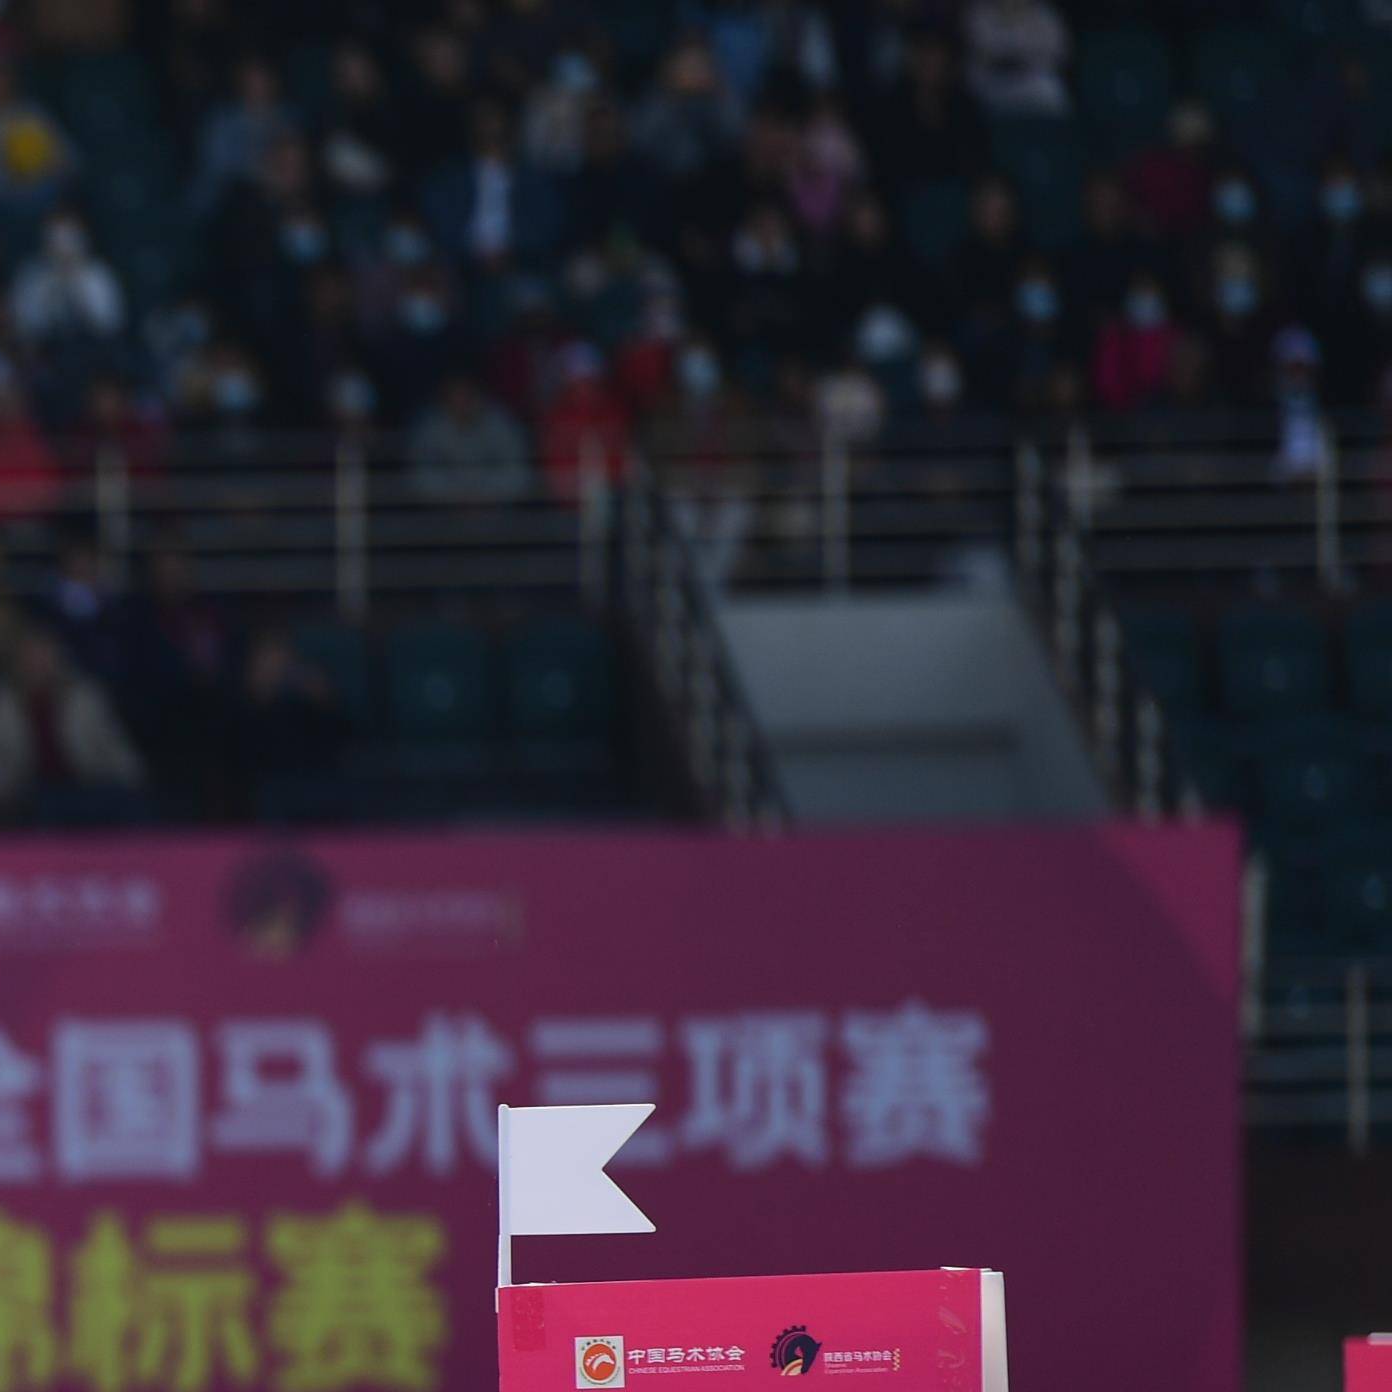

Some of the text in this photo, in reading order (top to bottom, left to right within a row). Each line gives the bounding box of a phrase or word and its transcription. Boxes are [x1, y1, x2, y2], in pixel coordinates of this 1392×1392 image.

[628, 1345, 746, 1366] 中国马术协会
